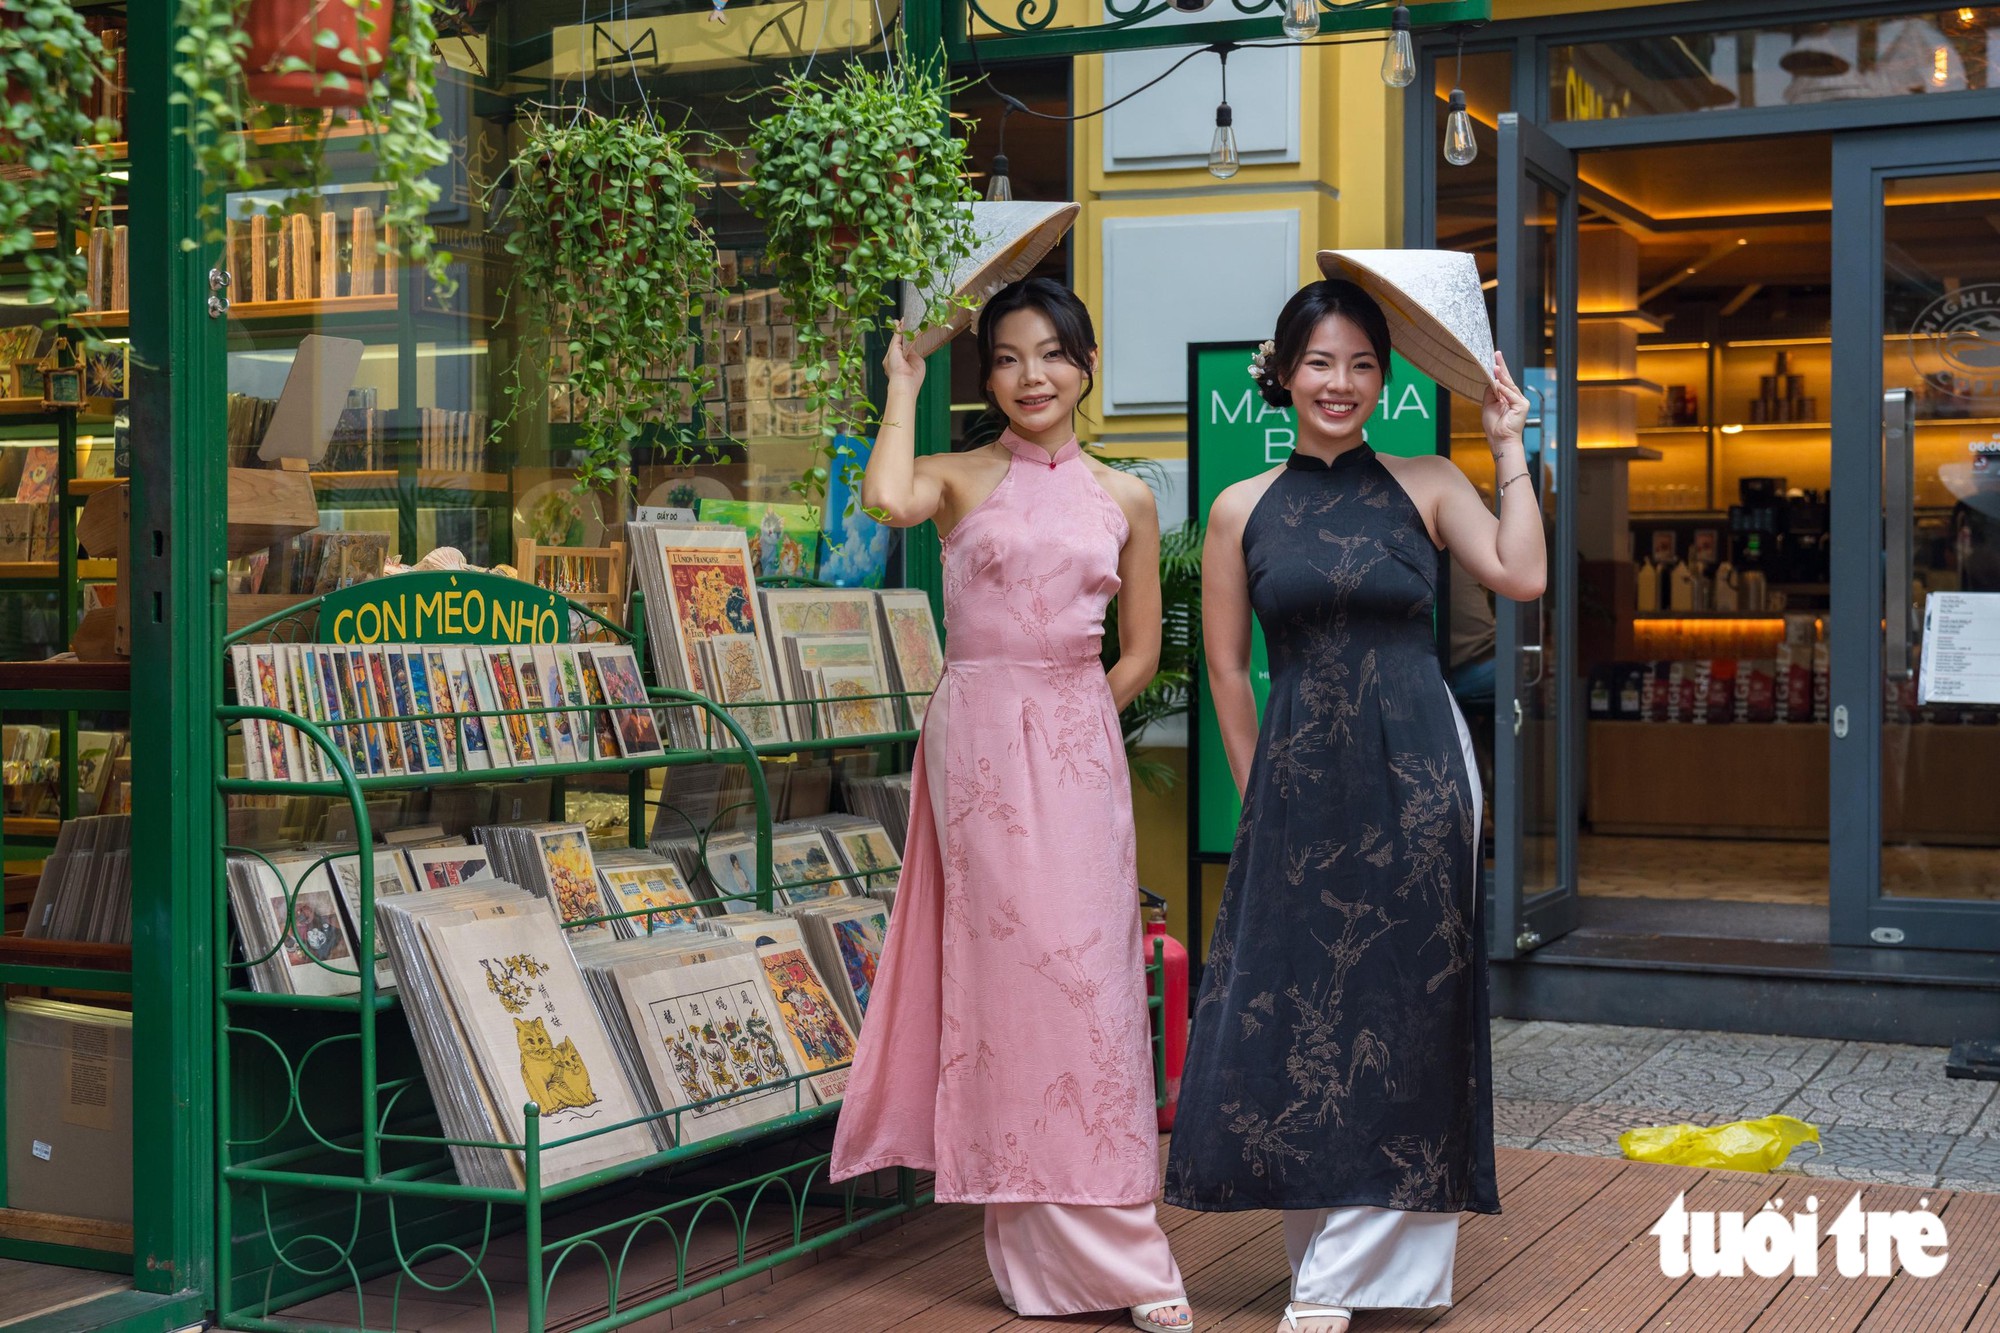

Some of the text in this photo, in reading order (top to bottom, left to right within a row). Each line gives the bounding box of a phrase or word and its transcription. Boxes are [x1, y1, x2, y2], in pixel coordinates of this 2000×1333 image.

[1211, 384, 1430, 425] MAHA
[334, 575, 559, 644] CON MÈO NHỎ
